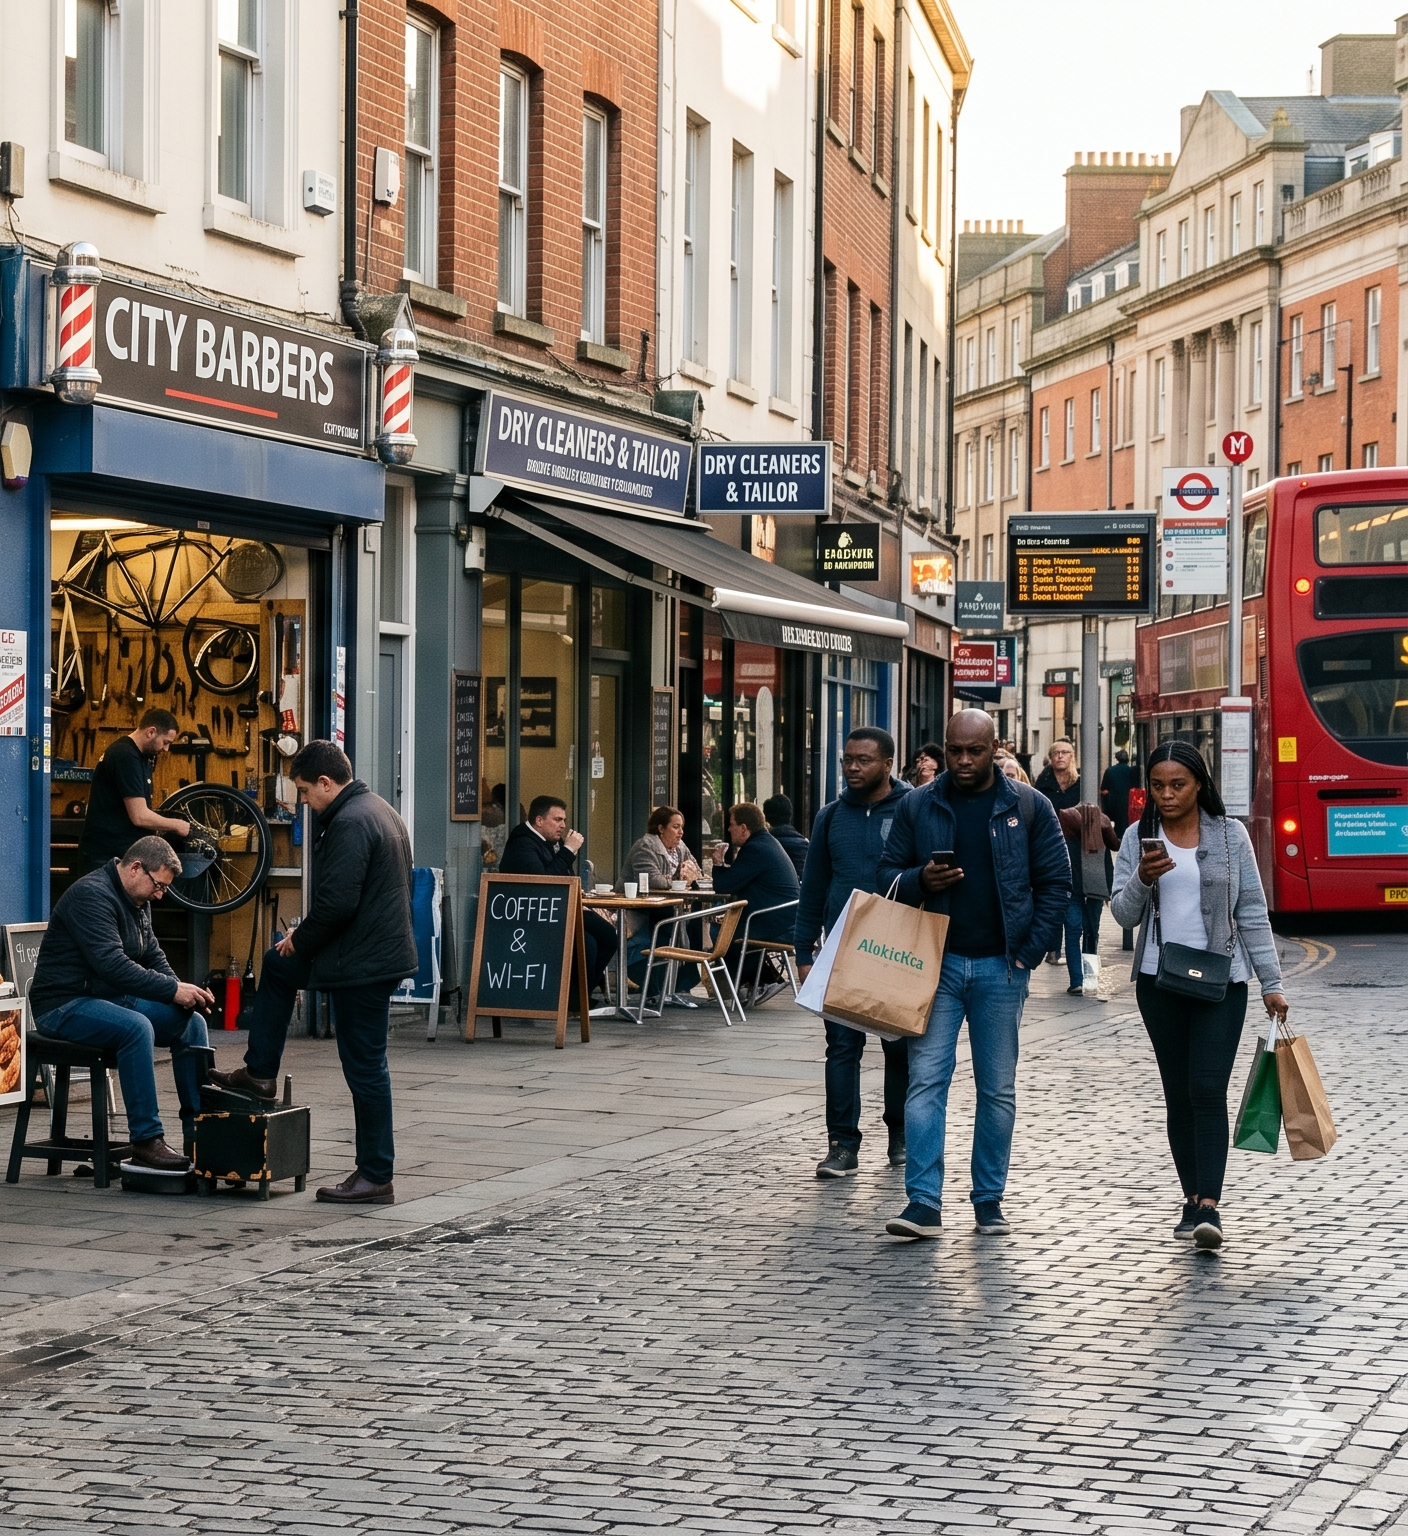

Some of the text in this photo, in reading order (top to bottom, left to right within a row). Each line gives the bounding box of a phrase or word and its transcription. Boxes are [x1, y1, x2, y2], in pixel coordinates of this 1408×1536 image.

[105, 296, 334, 406] CITY BARBERS
[498, 405, 535, 446] DRY
[536, 416, 616, 466] CLEANERS
[617, 436, 629, 470] &
[632, 440, 680, 481] TAILOR
[1229, 435, 1248, 455] M
[704, 454, 821, 475] DRY CLEANERS
[725, 481, 799, 503] & TAILOR
[490, 892, 562, 923] COFFEE
[509, 927, 526, 954] &
[486, 961, 548, 990] WI-FI
